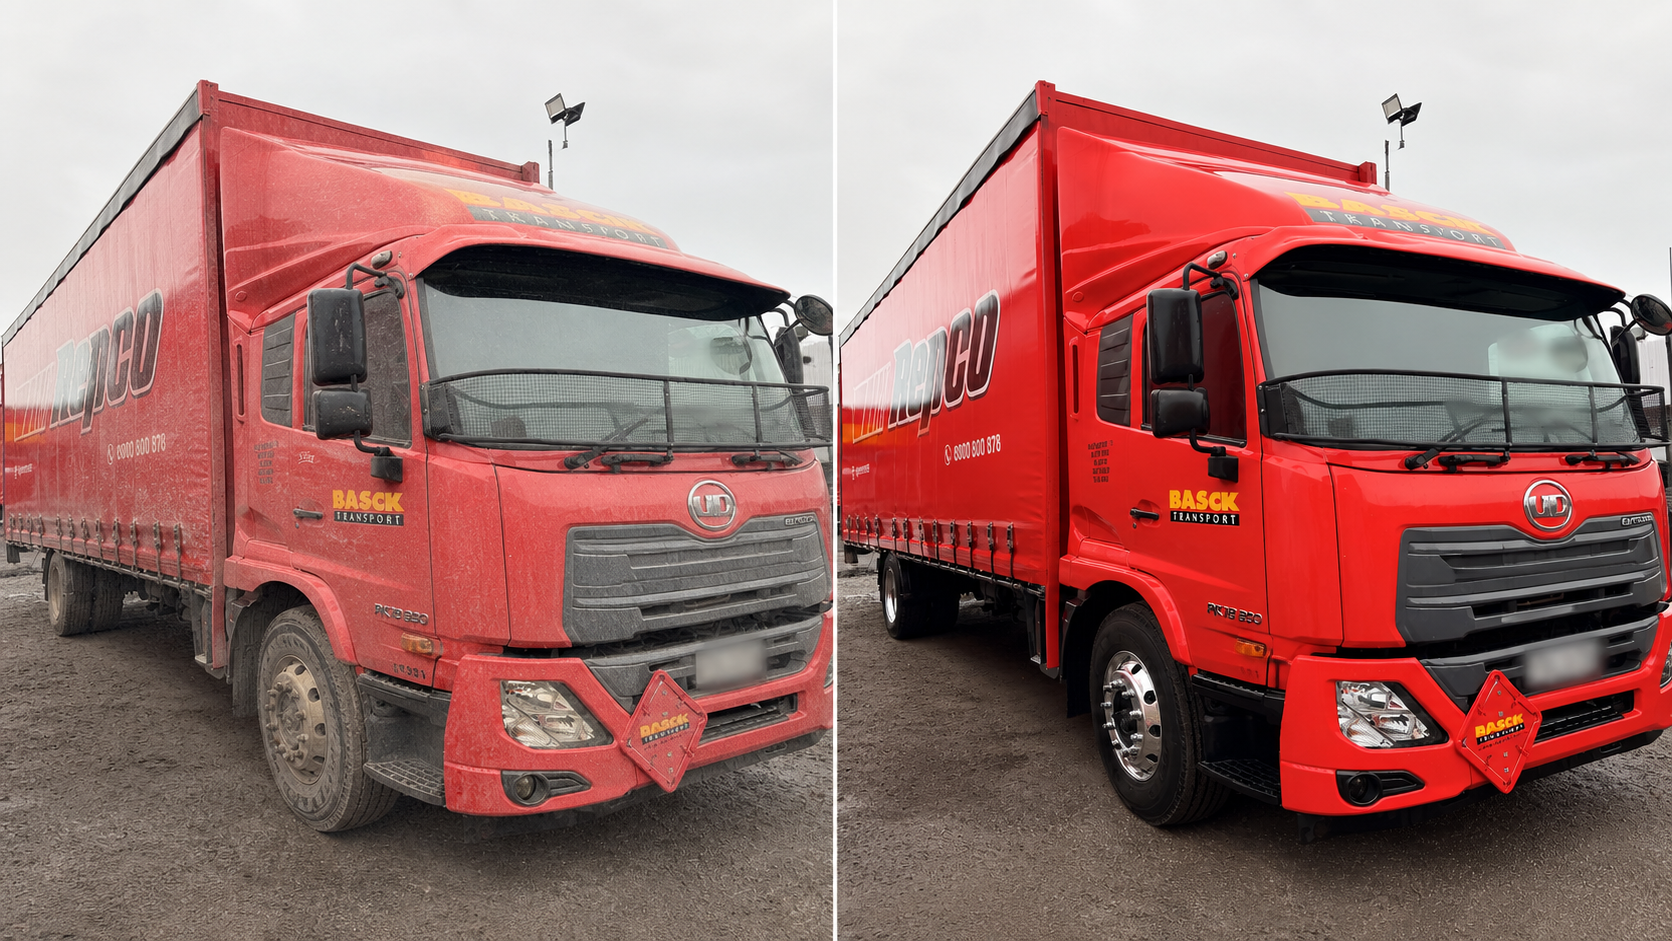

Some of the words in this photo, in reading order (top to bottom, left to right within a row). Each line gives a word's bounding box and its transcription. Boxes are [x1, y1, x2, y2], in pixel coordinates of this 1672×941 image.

[444, 188, 660, 236] BASCK
[1284, 191, 1499, 238] BASCK
[333, 489, 405, 512] BASCK
[692, 494, 734, 518] UD
[1169, 489, 1240, 512] BASCK
[1528, 494, 1569, 518] UD
[336, 511, 401, 525] TRANSPORT
[1173, 511, 1237, 525] TRANSPORT
